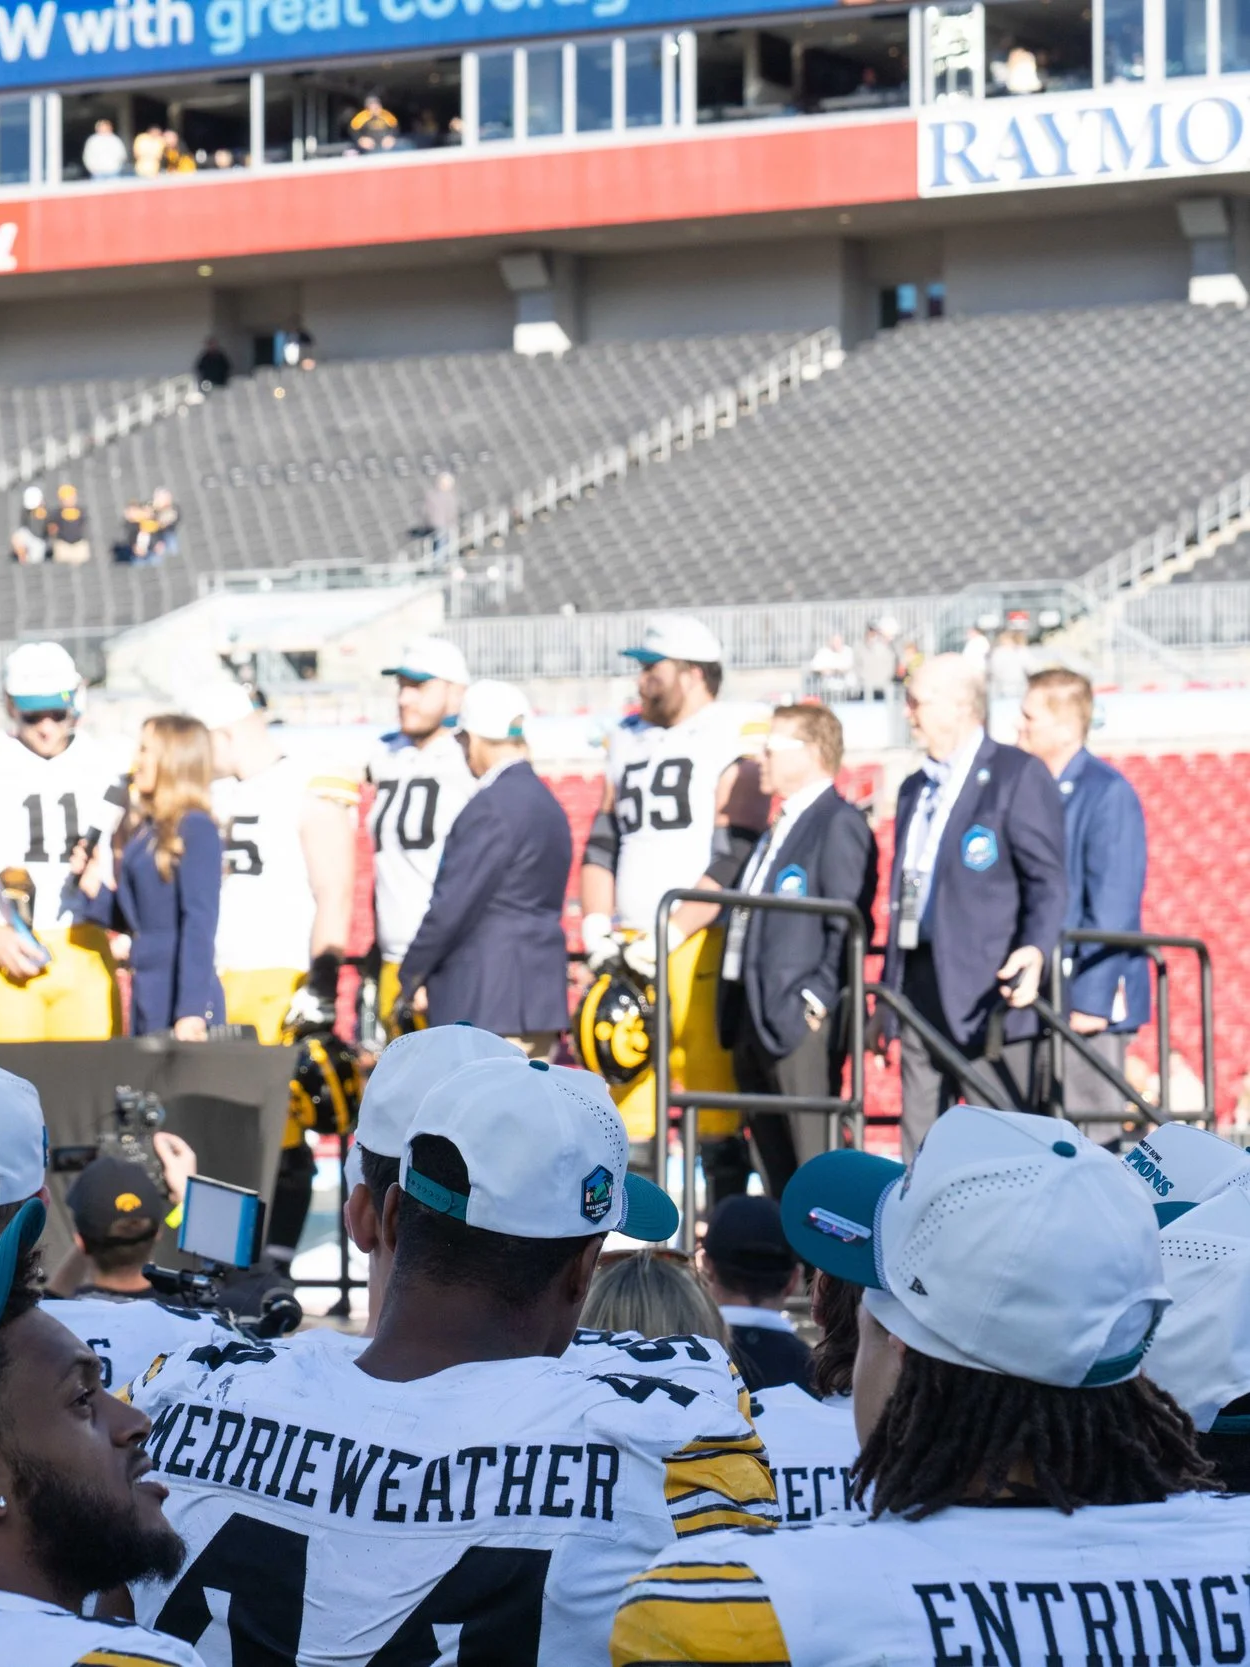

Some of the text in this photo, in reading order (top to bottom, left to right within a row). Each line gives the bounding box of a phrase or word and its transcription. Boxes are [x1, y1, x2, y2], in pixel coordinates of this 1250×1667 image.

[63, 0, 194, 56] with
[205, 0, 369, 56] great
[928, 97, 1244, 188] RAYMO
[22, 792, 81, 863] 11
[375, 777, 440, 851] 70
[620, 757, 694, 834] 59
[141, 1402, 619, 1523] MERRIEWEATHER
